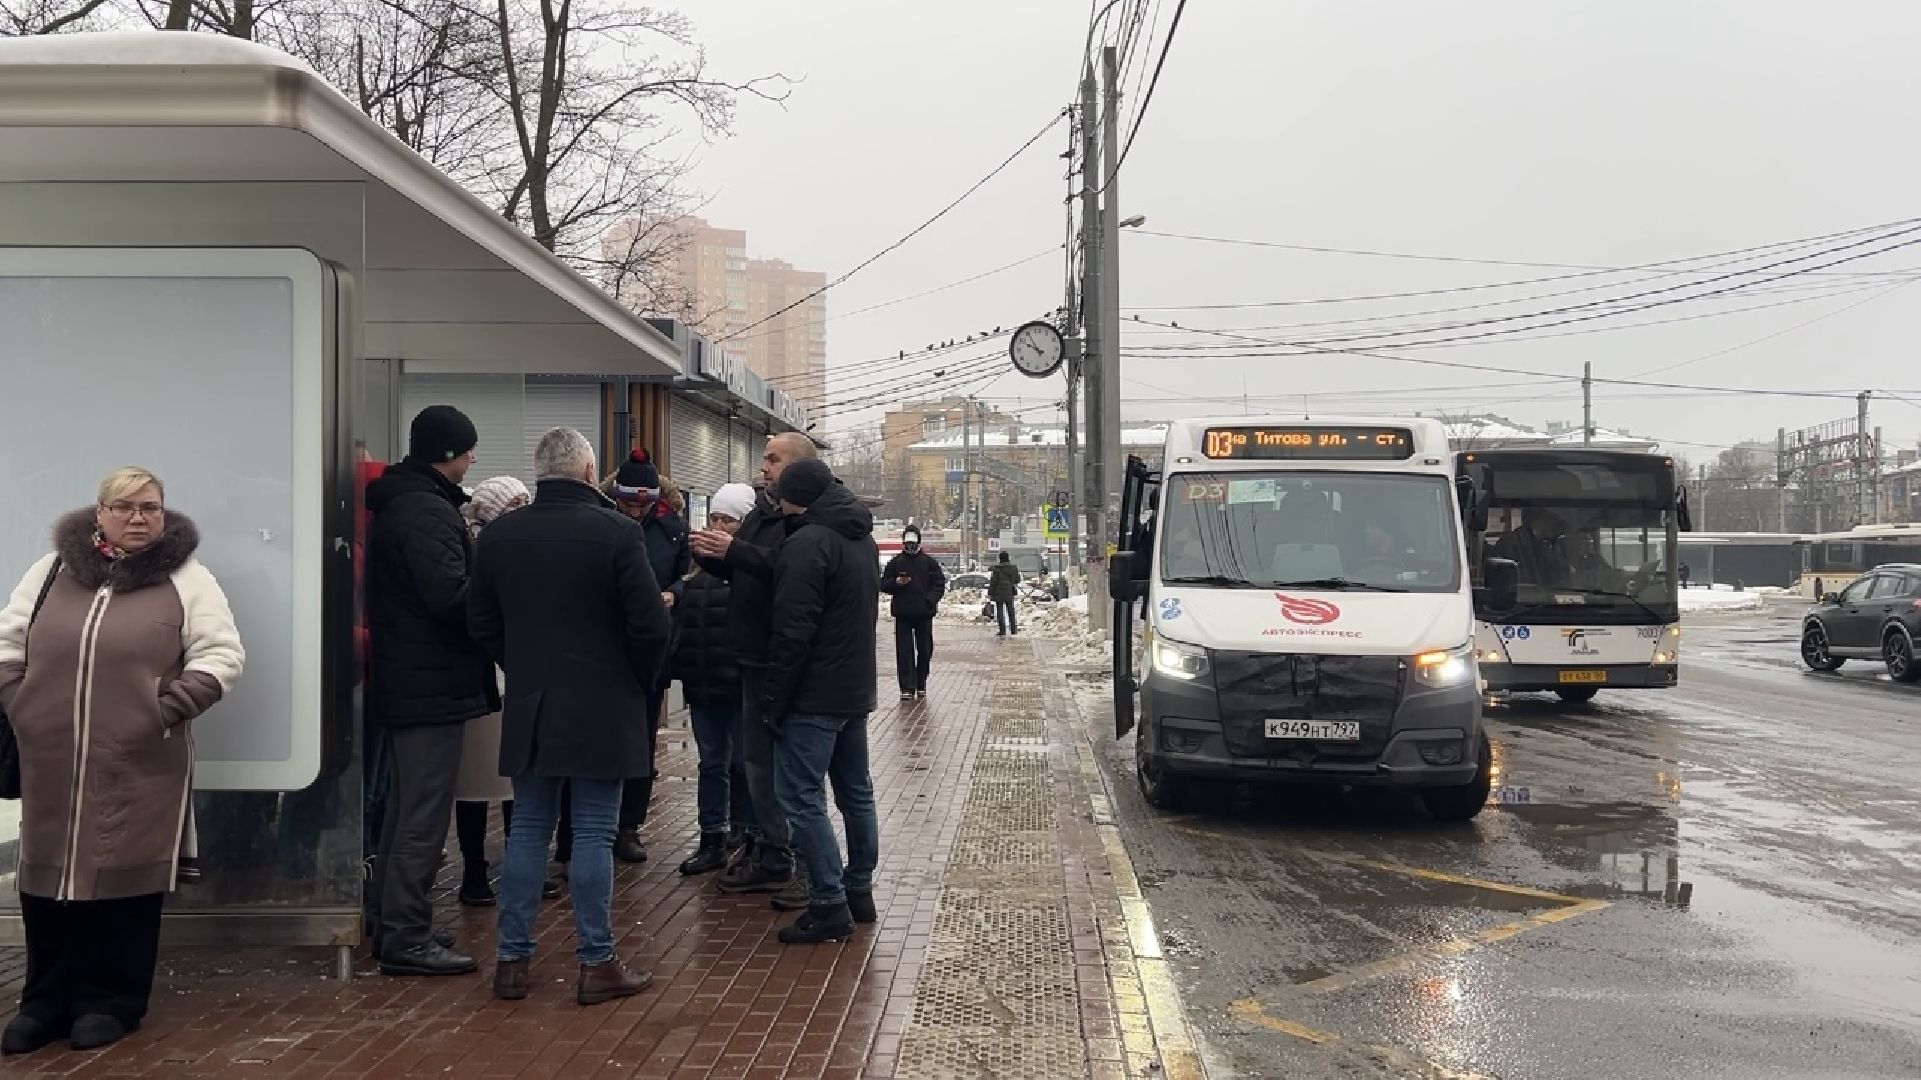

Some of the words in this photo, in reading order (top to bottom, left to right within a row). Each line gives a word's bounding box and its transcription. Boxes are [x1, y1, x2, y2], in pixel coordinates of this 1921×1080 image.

[1254, 432, 1312, 445] Титова
[1318, 433, 1348, 446] ул.
[1376, 433, 1404, 445] ст.
[1261, 628, 1364, 638] АВТОЭКСПРЕСС
